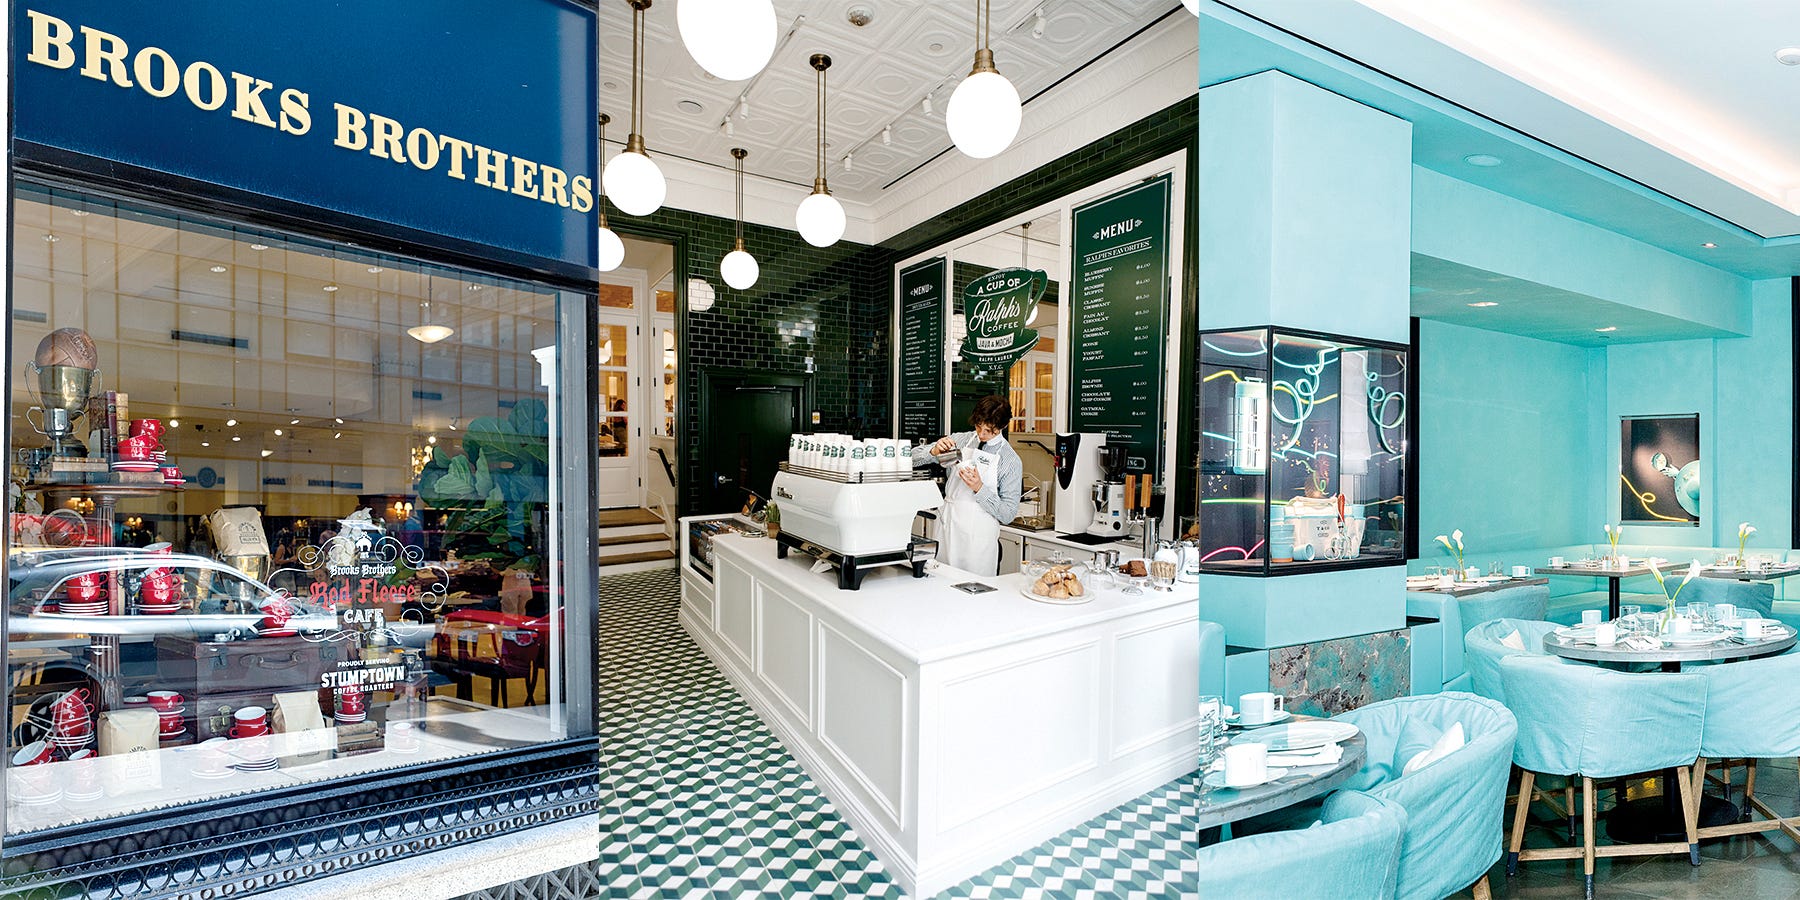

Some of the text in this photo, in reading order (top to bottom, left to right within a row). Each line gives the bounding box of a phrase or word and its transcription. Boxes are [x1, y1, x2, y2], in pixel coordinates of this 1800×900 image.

[27, 9, 594, 213] BROOKS BROTHERS
[1100, 218, 1134, 240] MENU
[1112, 241, 1150, 256] FAVORITES
[1084, 274, 1104, 282] MUFFIN
[913, 284, 930, 296] MENU
[976, 278, 1021, 297] A CUP OF
[1083, 289, 1104, 297] MUFFIN
[968, 296, 1021, 338] Ralph's
[987, 321, 1019, 333] COFFEE
[1082, 326, 1104, 334] ALMOND
[978, 340, 991, 348] JAVA
[995, 335, 1013, 347] MOCHA
[330, 563, 397, 578] Brooks Brothers
[308, 578, 415, 611] Red Fleece
[337, 657, 390, 668] PROUDLY SERVING
[321, 665, 405, 688] STUMPTOWN
[333, 682, 394, 695] COFFEE ROASTERS
